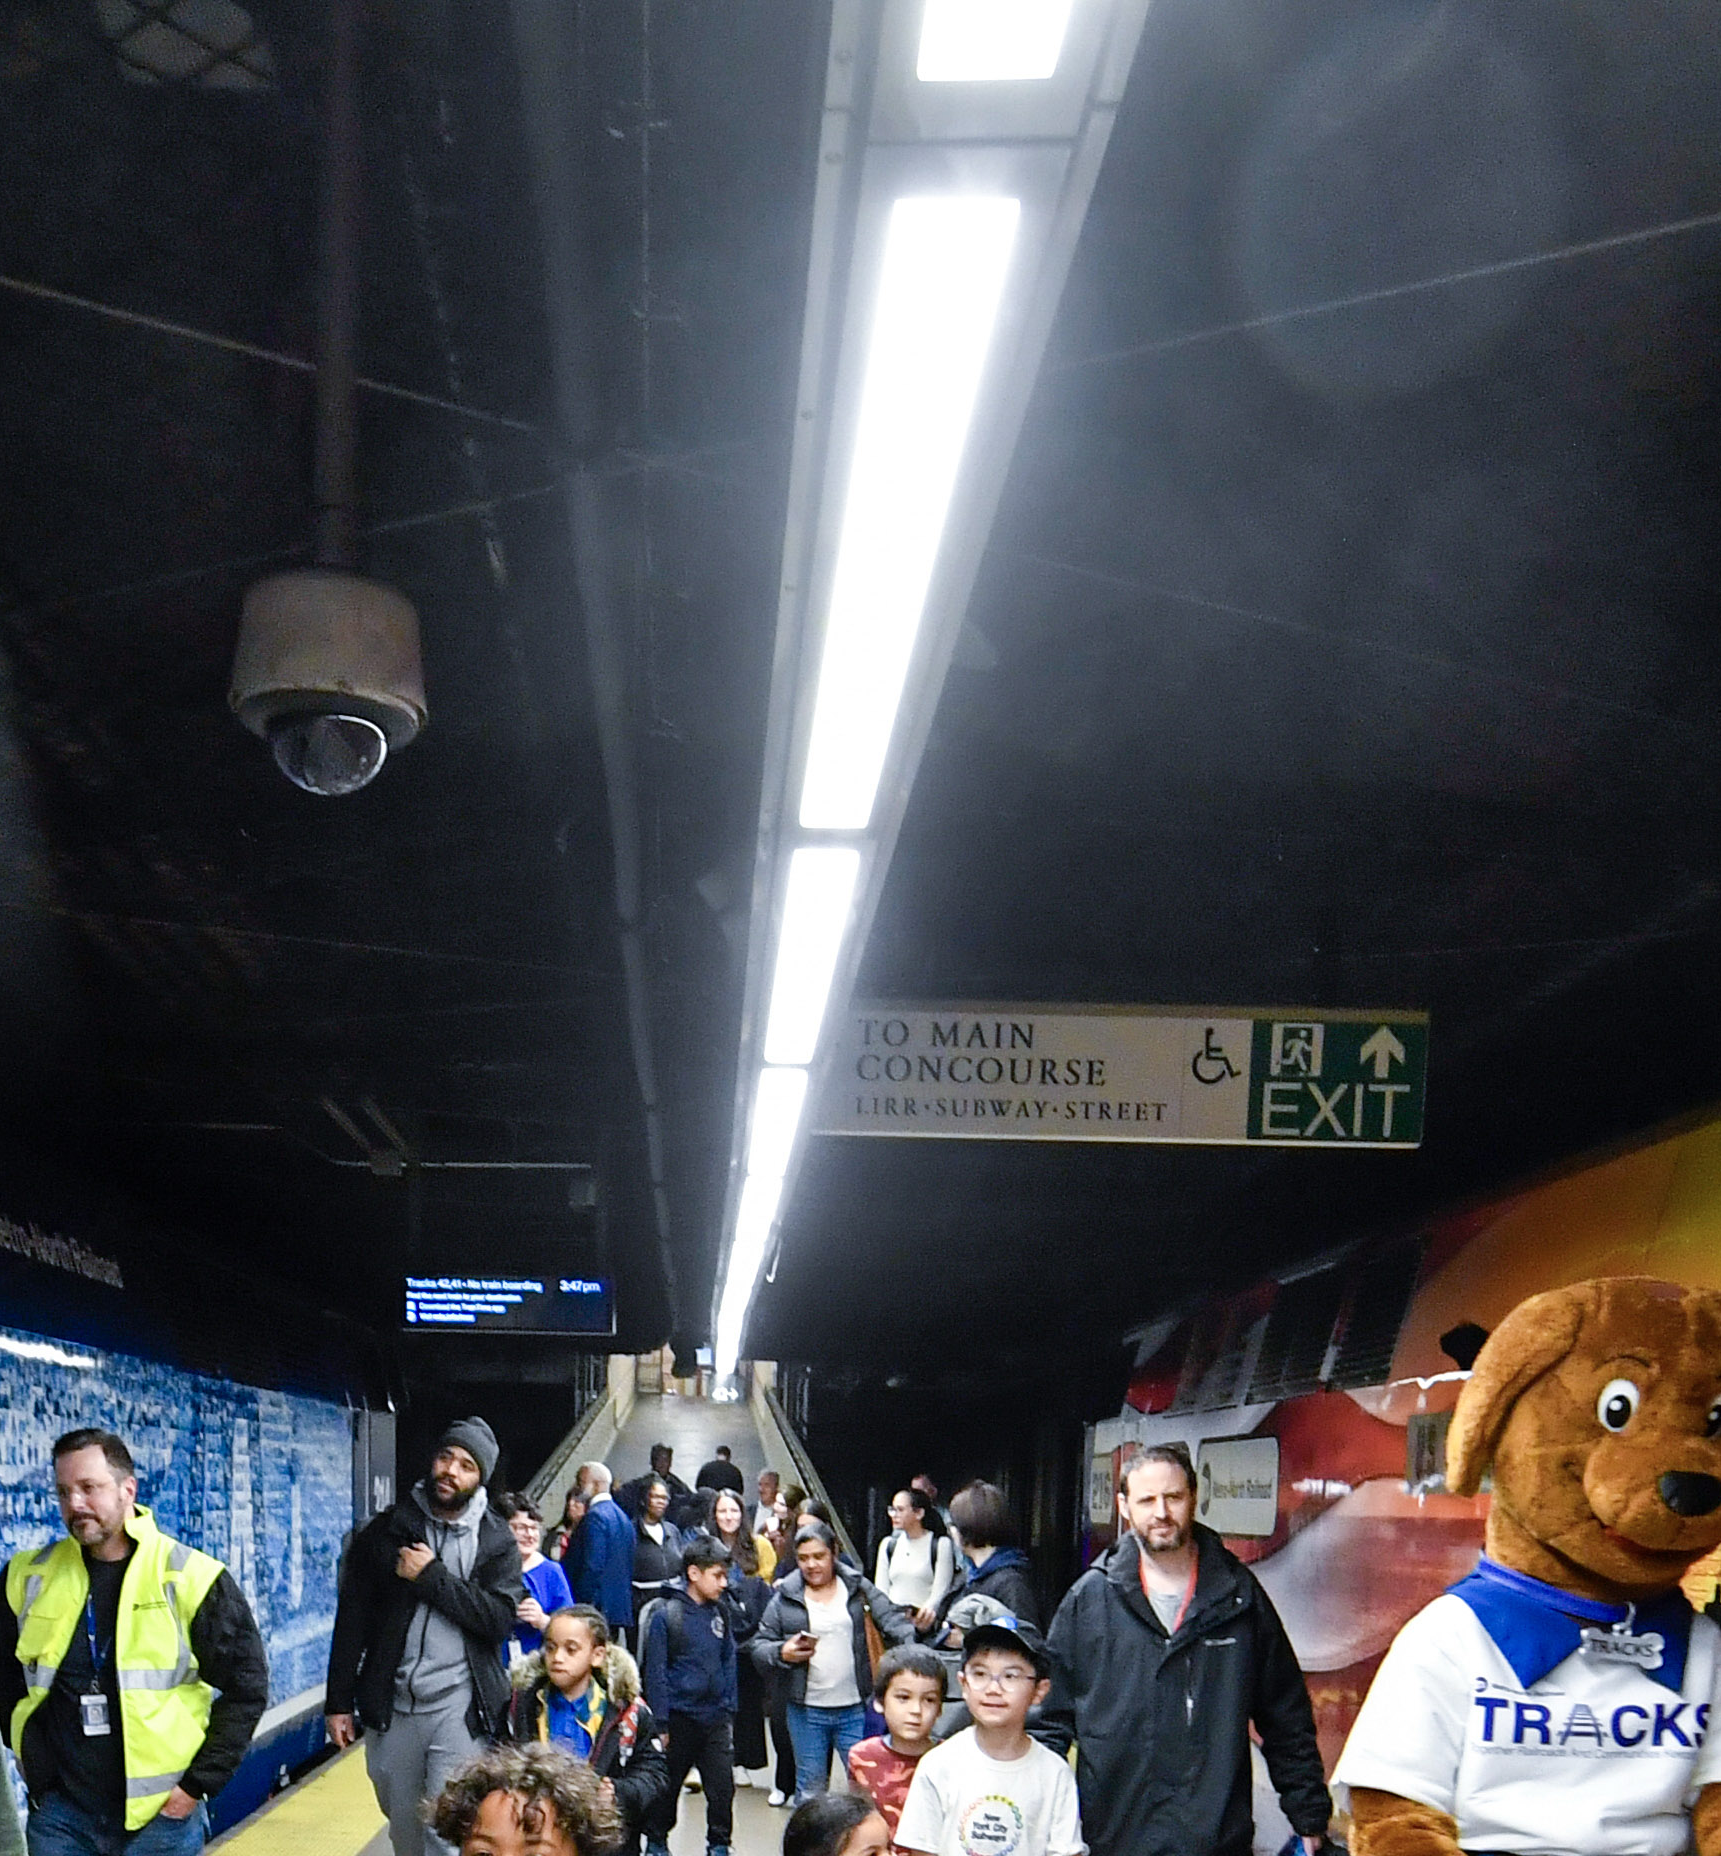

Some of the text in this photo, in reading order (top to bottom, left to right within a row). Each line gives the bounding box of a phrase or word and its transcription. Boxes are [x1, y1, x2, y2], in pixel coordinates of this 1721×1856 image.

[857, 1018, 1035, 1050] TO MAIN
[855, 1053, 1107, 1087] CONCOURSE
[1260, 1081, 1411, 1138] EXIT
[1590, 1638, 1655, 1658] TRACKS
